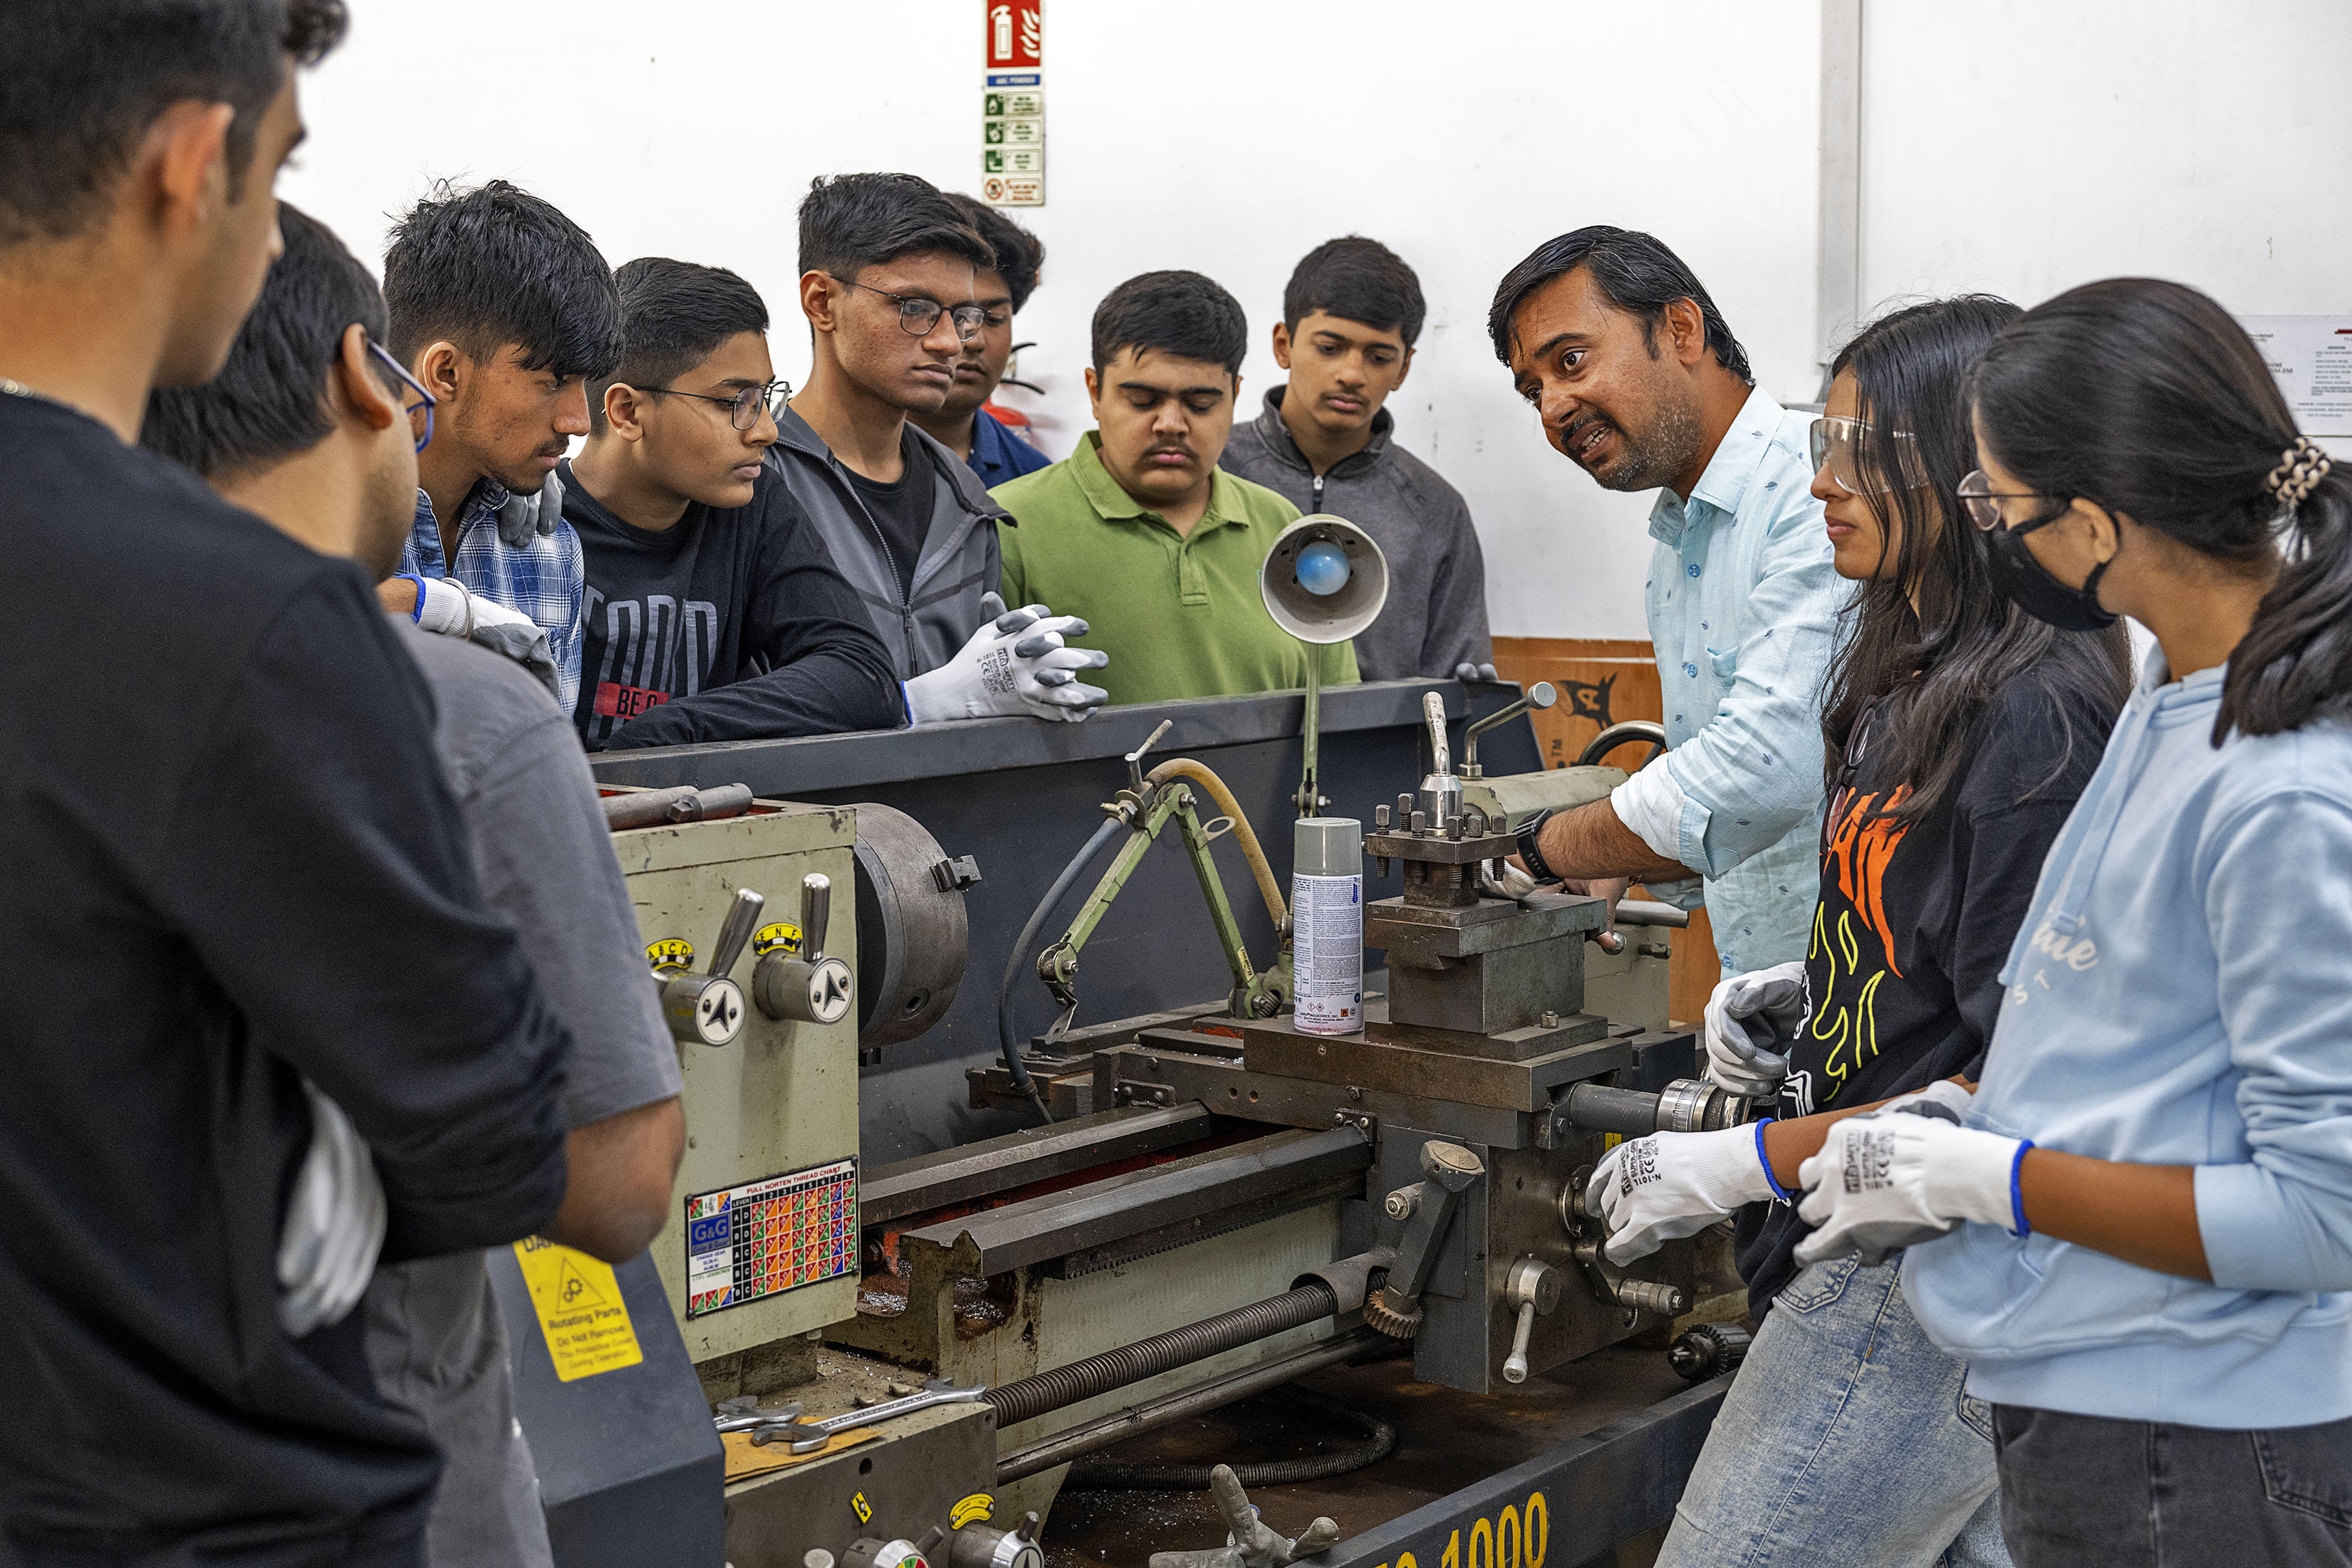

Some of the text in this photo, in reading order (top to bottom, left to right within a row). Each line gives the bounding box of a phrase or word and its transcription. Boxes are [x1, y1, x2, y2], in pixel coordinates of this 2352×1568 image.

[617, 689, 641, 716] BE
[776, 928, 781, 937] N
[791, 929, 797, 939] F
[659, 945, 664, 955] B
[668, 943, 676, 953] C
[680, 945, 687, 955] D
[1644, 1159, 1654, 1173] CE
[765, 1179, 791, 1189] NORTEN
[793, 1172, 818, 1182] THREAD
[820, 1166, 841, 1176] CHART
[694, 1218, 727, 1241] G&G
[548, 1307, 622, 1329] Rotating Parts
